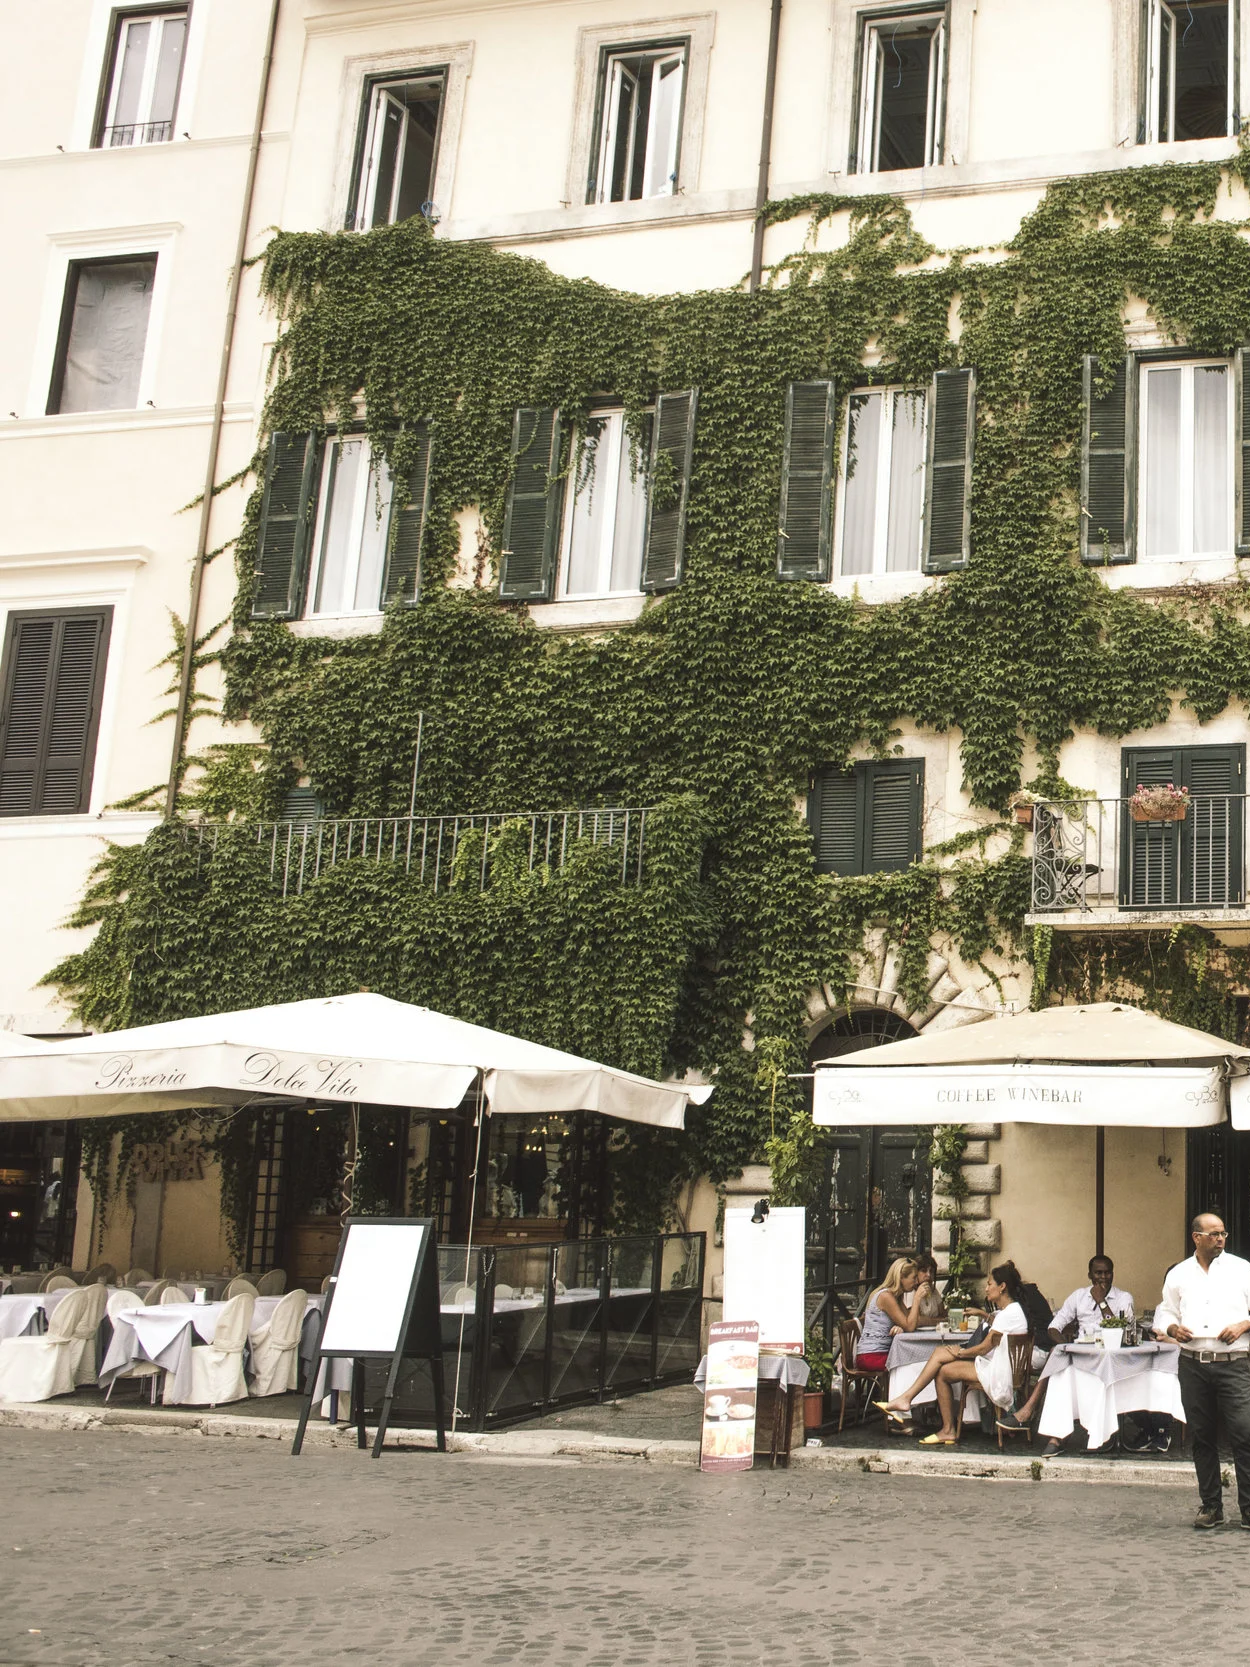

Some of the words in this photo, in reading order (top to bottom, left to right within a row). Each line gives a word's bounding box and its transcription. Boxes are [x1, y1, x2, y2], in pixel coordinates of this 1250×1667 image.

[95, 1054, 187, 1090] Pizzeria
[239, 1051, 311, 1091] Dolce
[314, 1058, 363, 1096] Vita
[936, 1087, 996, 1103] COFFEE
[1007, 1087, 1082, 1103] WINEBAR
[710, 1327, 745, 1335] BREAKFAST
